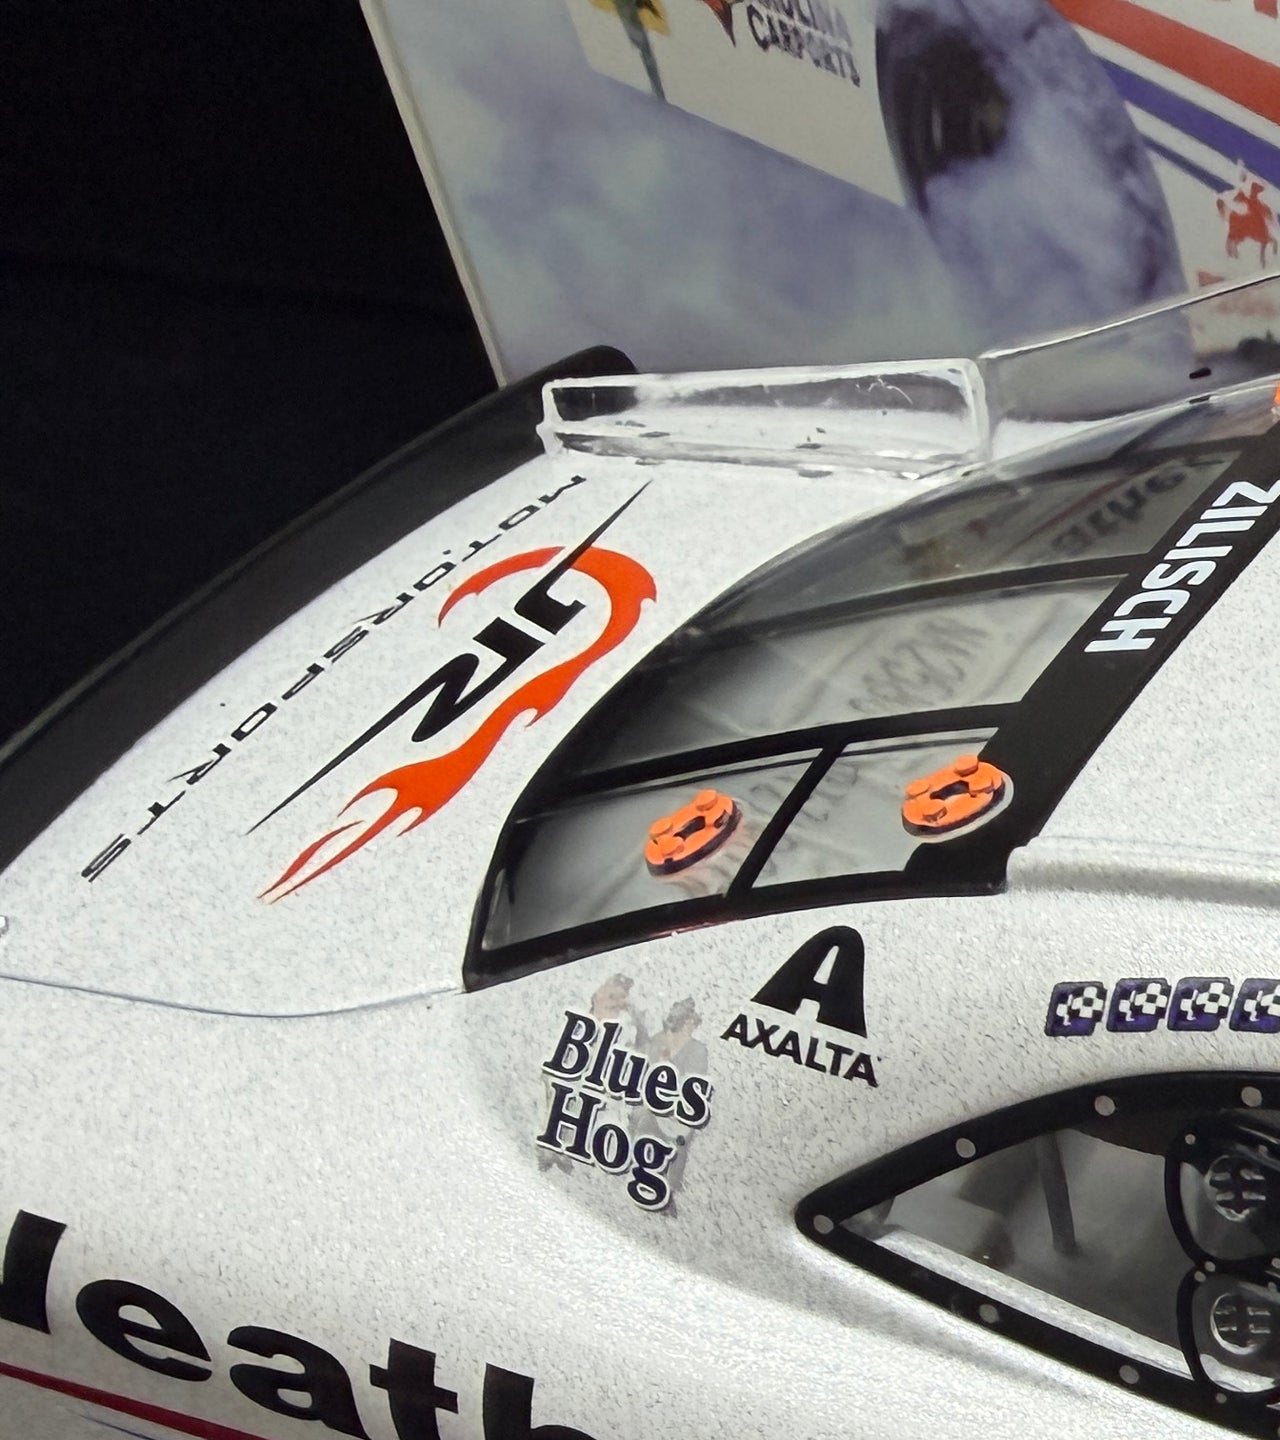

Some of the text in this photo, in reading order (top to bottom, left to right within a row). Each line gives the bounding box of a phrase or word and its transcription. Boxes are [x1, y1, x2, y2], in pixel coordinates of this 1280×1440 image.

[81, 475, 586, 882] MOTORSPORTS
[542, 1010, 714, 1127] Blues
[719, 1013, 879, 1088] AXALTA
[536, 1082, 676, 1210] Hog
